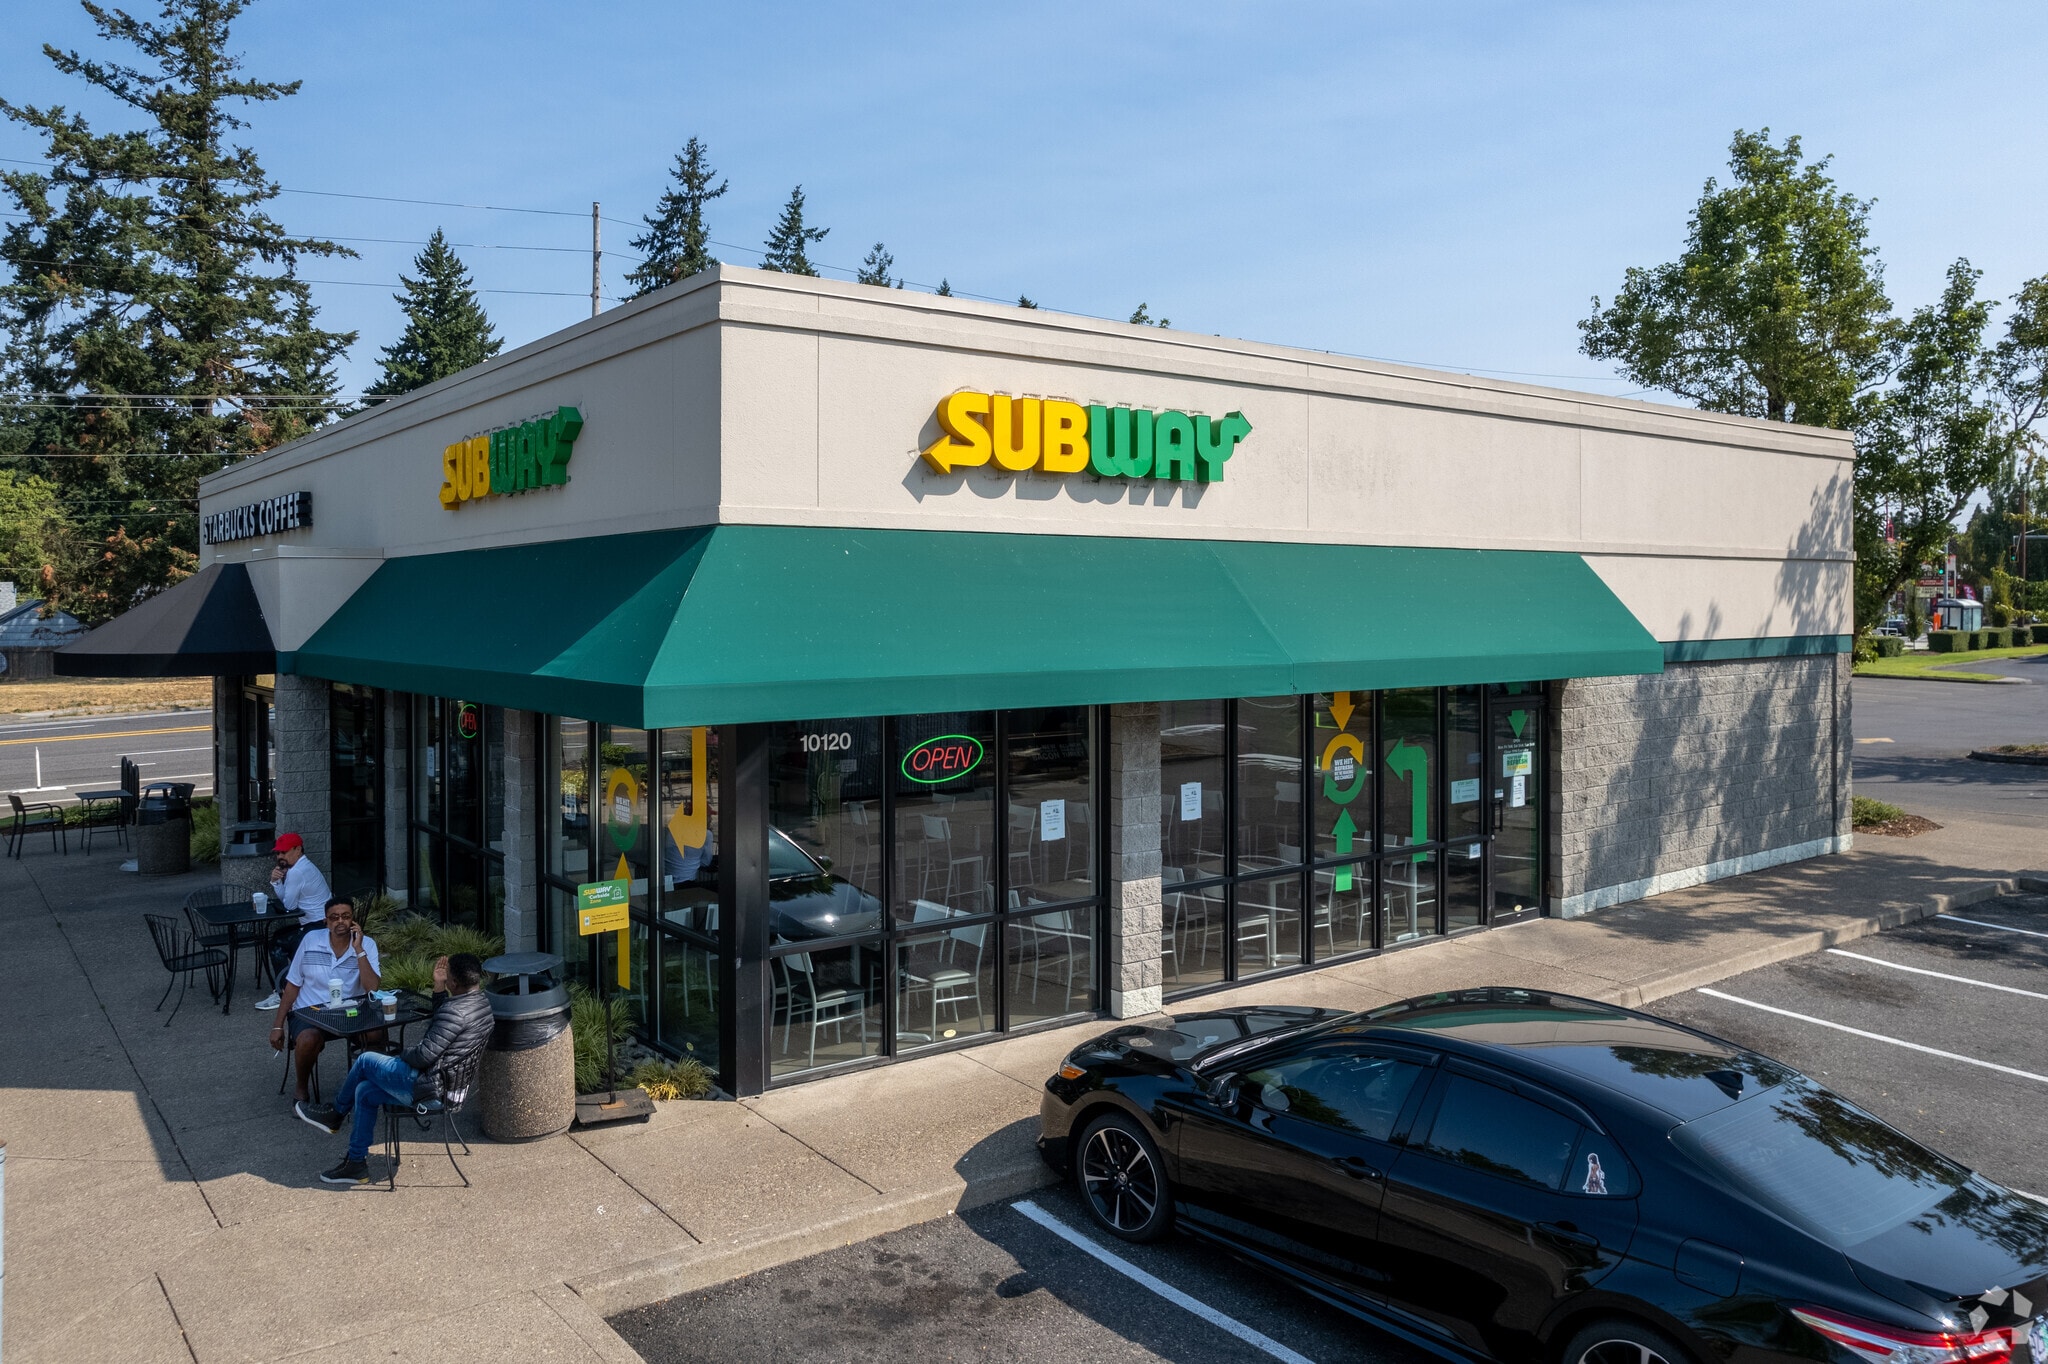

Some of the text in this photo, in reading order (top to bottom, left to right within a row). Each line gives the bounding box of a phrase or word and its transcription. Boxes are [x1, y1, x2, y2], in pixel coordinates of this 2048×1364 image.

[921, 391, 1253, 483] SUBWAY
[439, 406, 584, 511] SUBWAY
[203, 491, 303, 545] STARBUCKS COFFEE
[461, 711, 477, 731] OPEN
[800, 732, 852, 753] 10120
[912, 745, 973, 772] OPEN
[1343, 757, 1354, 765] HIT
[583, 885, 613, 896] SUBWAY
